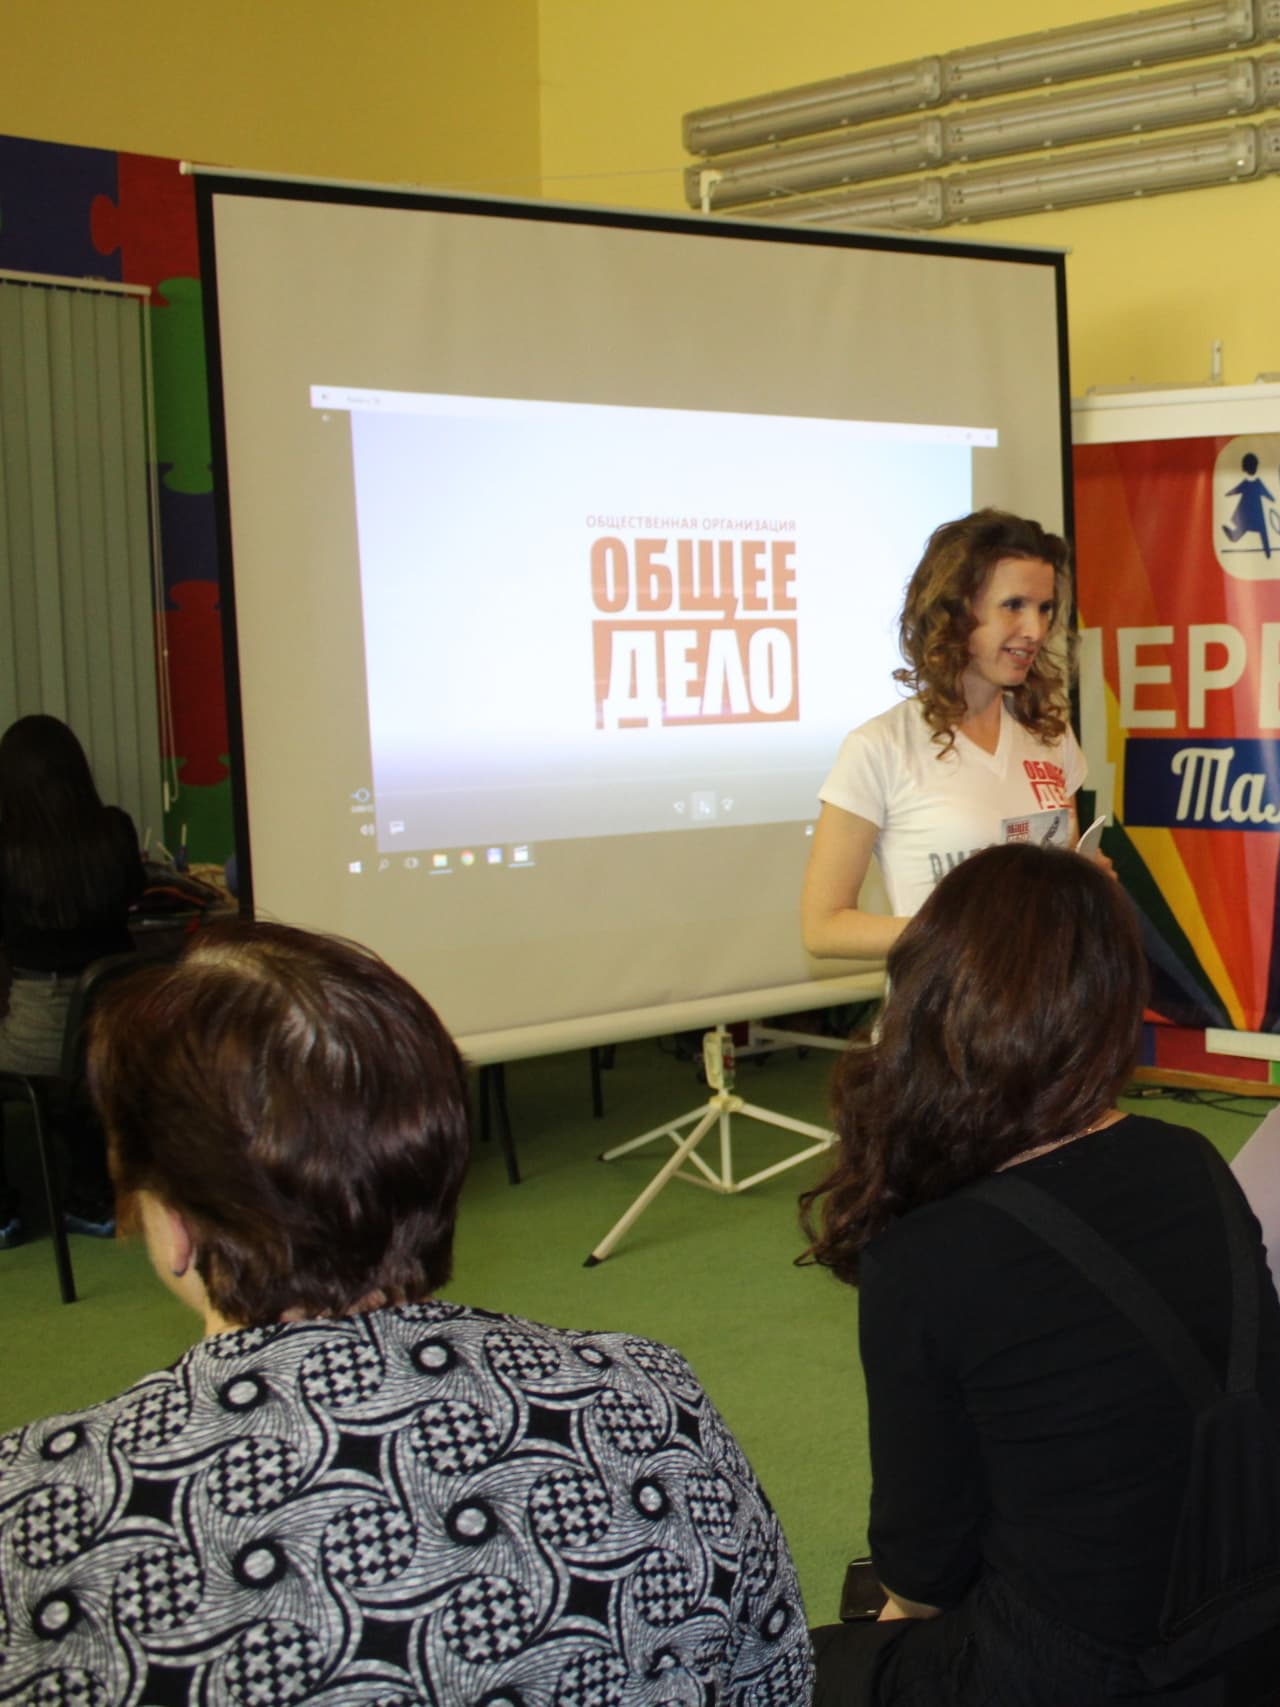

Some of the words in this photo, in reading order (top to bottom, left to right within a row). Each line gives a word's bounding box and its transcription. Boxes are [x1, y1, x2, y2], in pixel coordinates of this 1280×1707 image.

[586, 515, 698, 530] ОБЩЕСТВЕННАЯ
[702, 517, 796, 533] ОРГАНИЗАЦИЯ
[590, 536, 797, 618] ОБЩЕЕ
[602, 626, 794, 729] ДЕЛО
